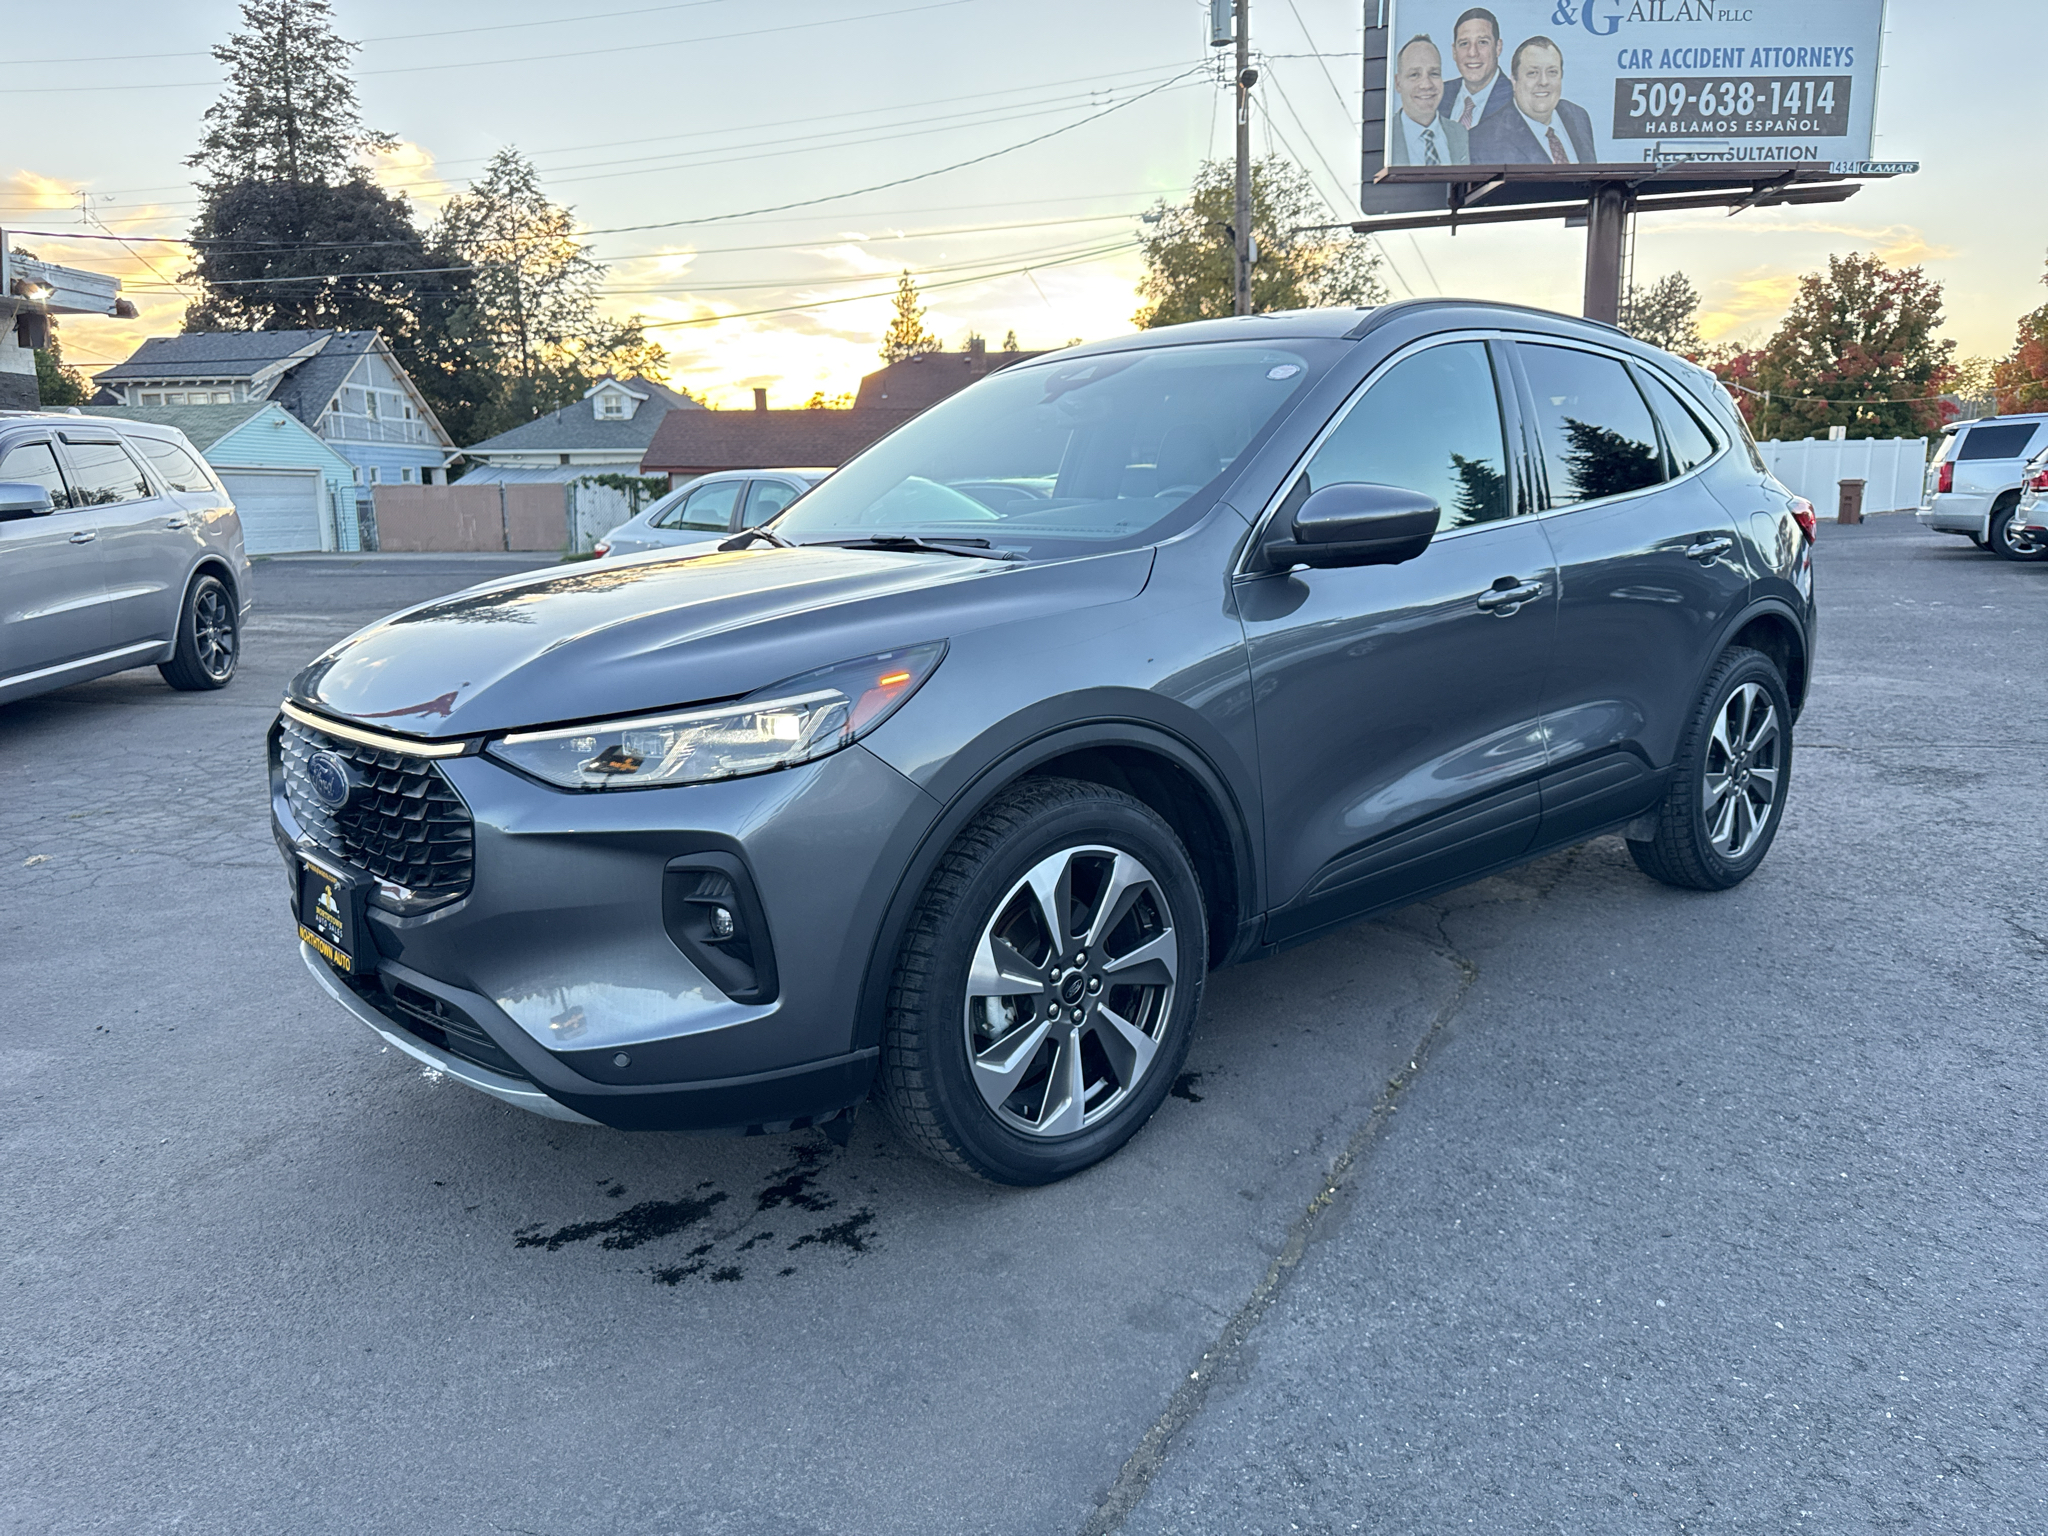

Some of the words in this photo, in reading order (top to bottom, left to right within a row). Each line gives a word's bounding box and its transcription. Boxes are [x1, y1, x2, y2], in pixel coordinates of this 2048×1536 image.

[1717, 9, 1753, 22] PLLC
[1617, 48, 1653, 70] CAR
[1659, 47, 1745, 70] ACCIDENT
[1750, 46, 1854, 69] ATTORNEYS
[1629, 80, 1835, 118] 509-638-1414
[1645, 120, 1738, 133] HABLAMOS
[1745, 117, 1821, 132] ESPAÑOL
[1867, 164, 1914, 173] LAMAR
[328, 922, 343, 938] SALES
[299, 925, 333, 960] NORTHTOWN
[333, 950, 351, 972] AUTO
